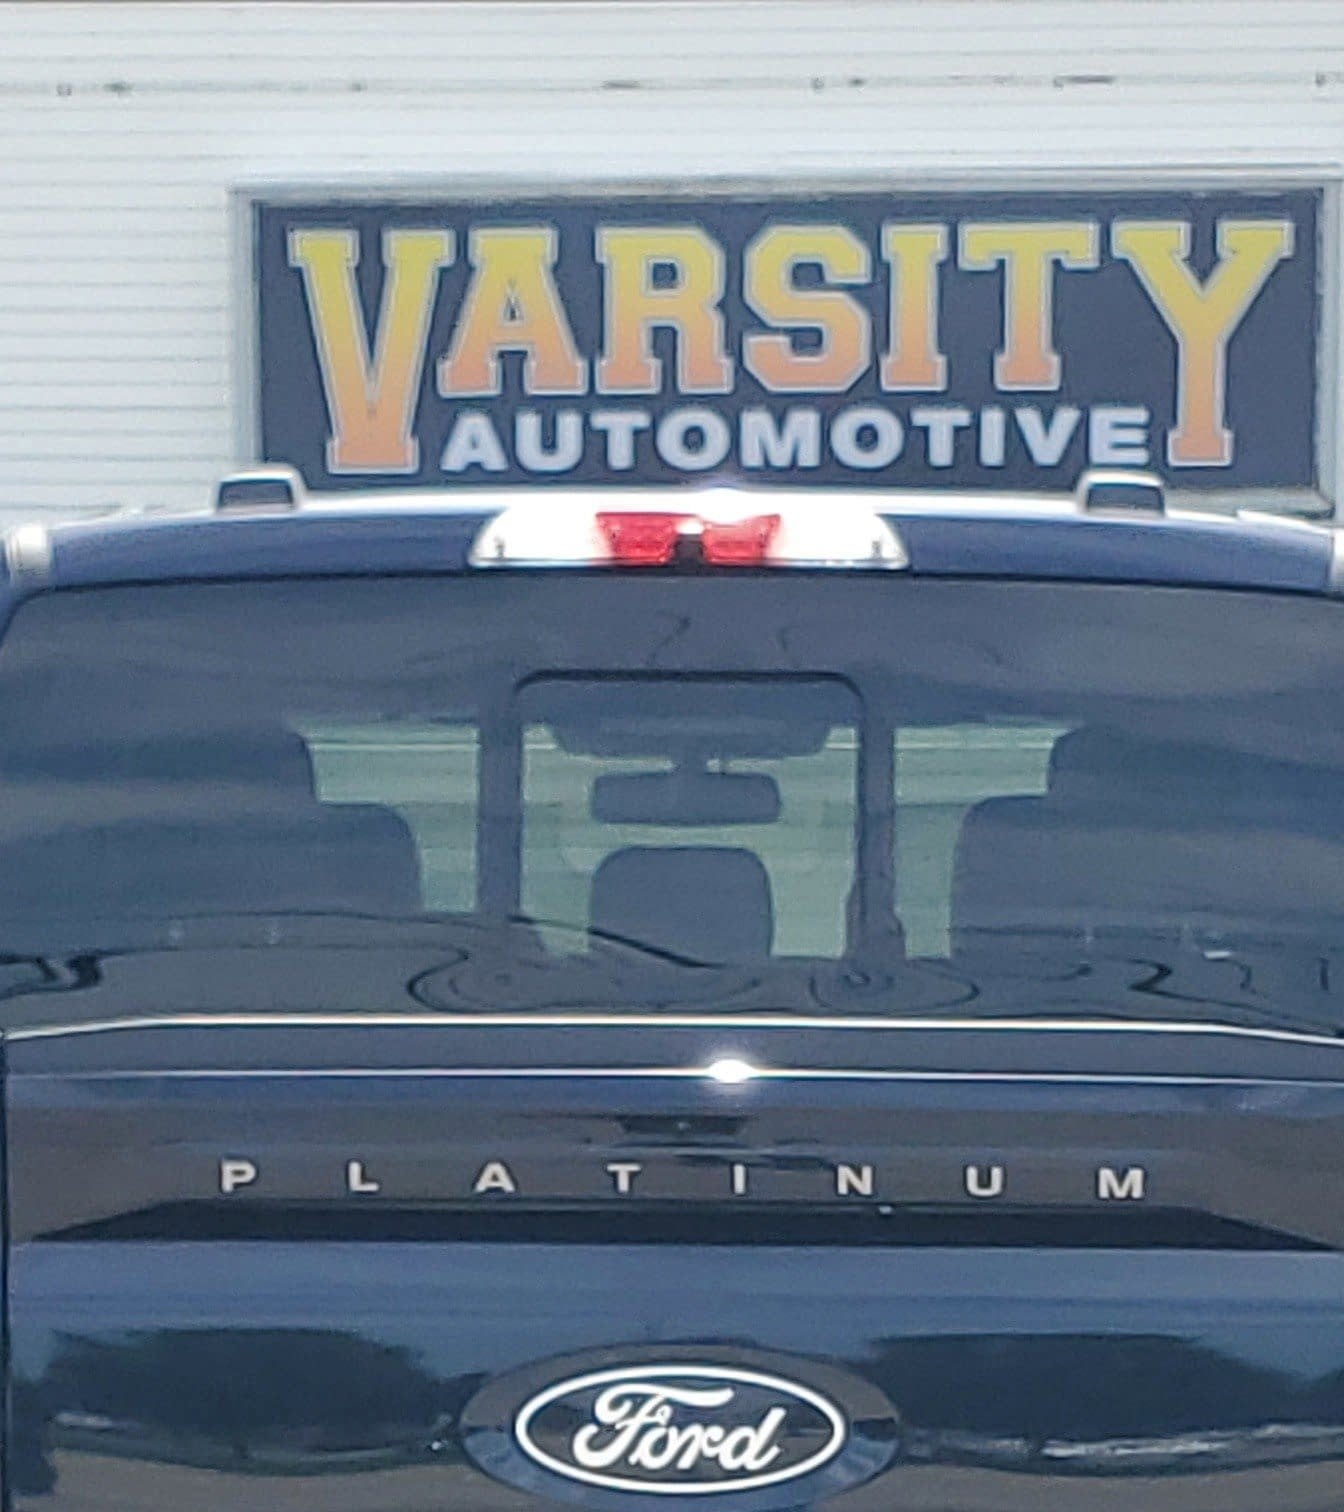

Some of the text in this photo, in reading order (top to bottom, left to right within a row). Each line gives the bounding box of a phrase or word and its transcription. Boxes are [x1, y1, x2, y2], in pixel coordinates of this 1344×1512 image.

[290, 222, 1294, 474] VARSITY
[440, 408, 1150, 473] AUTOMOTIVE
[221, 1161, 1147, 1200] PLATINUM
[574, 1384, 784, 1471] Ford
